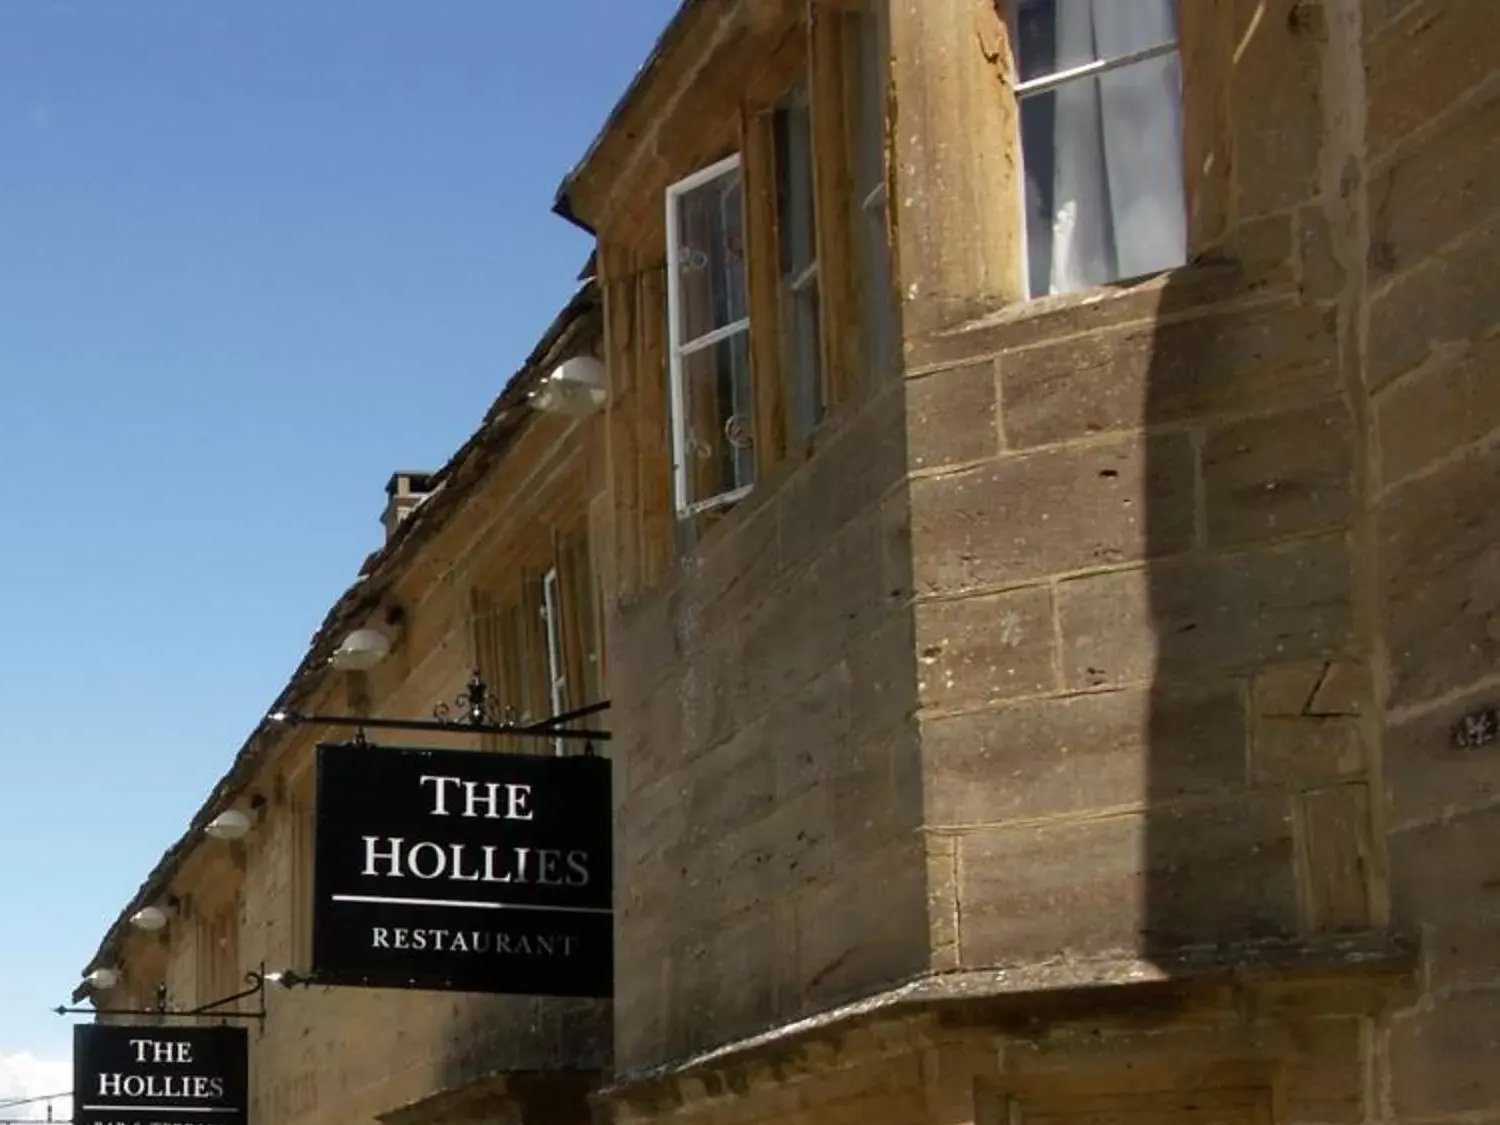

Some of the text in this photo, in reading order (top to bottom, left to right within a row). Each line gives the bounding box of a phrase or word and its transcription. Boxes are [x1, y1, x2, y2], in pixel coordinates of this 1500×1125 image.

[420, 775, 533, 820] THE
[361, 835, 589, 886] HOLLIES
[372, 927, 578, 956] RESTAURANT
[130, 1039, 193, 1063] THE
[99, 1073, 224, 1097] HOLLIES
